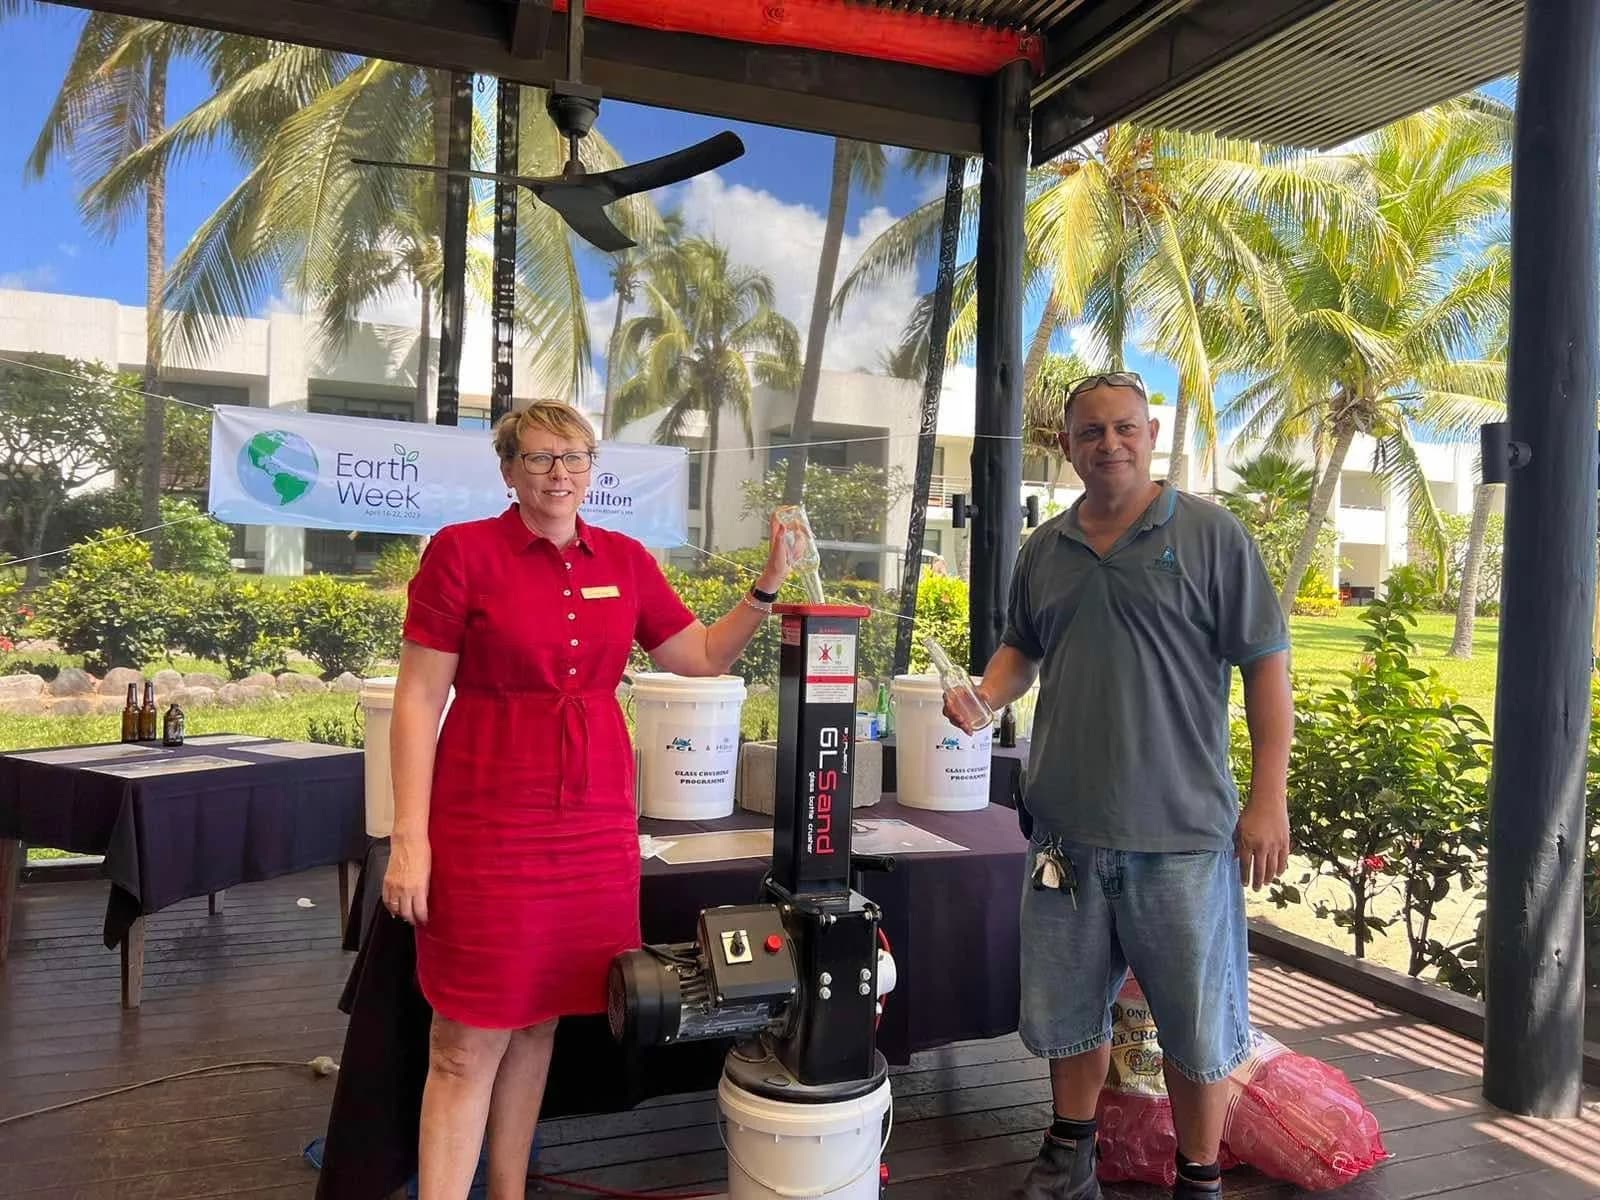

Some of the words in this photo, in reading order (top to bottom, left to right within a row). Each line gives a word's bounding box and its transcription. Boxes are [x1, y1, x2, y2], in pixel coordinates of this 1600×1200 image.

[336, 452, 418, 482] Earth
[336, 480, 421, 510] Week
[582, 490, 632, 507] Hilton
[808, 771, 816, 793] glass
[816, 726, 839, 854] GLSand
[808, 795, 816, 819] bottle
[806, 823, 815, 854] crusher
